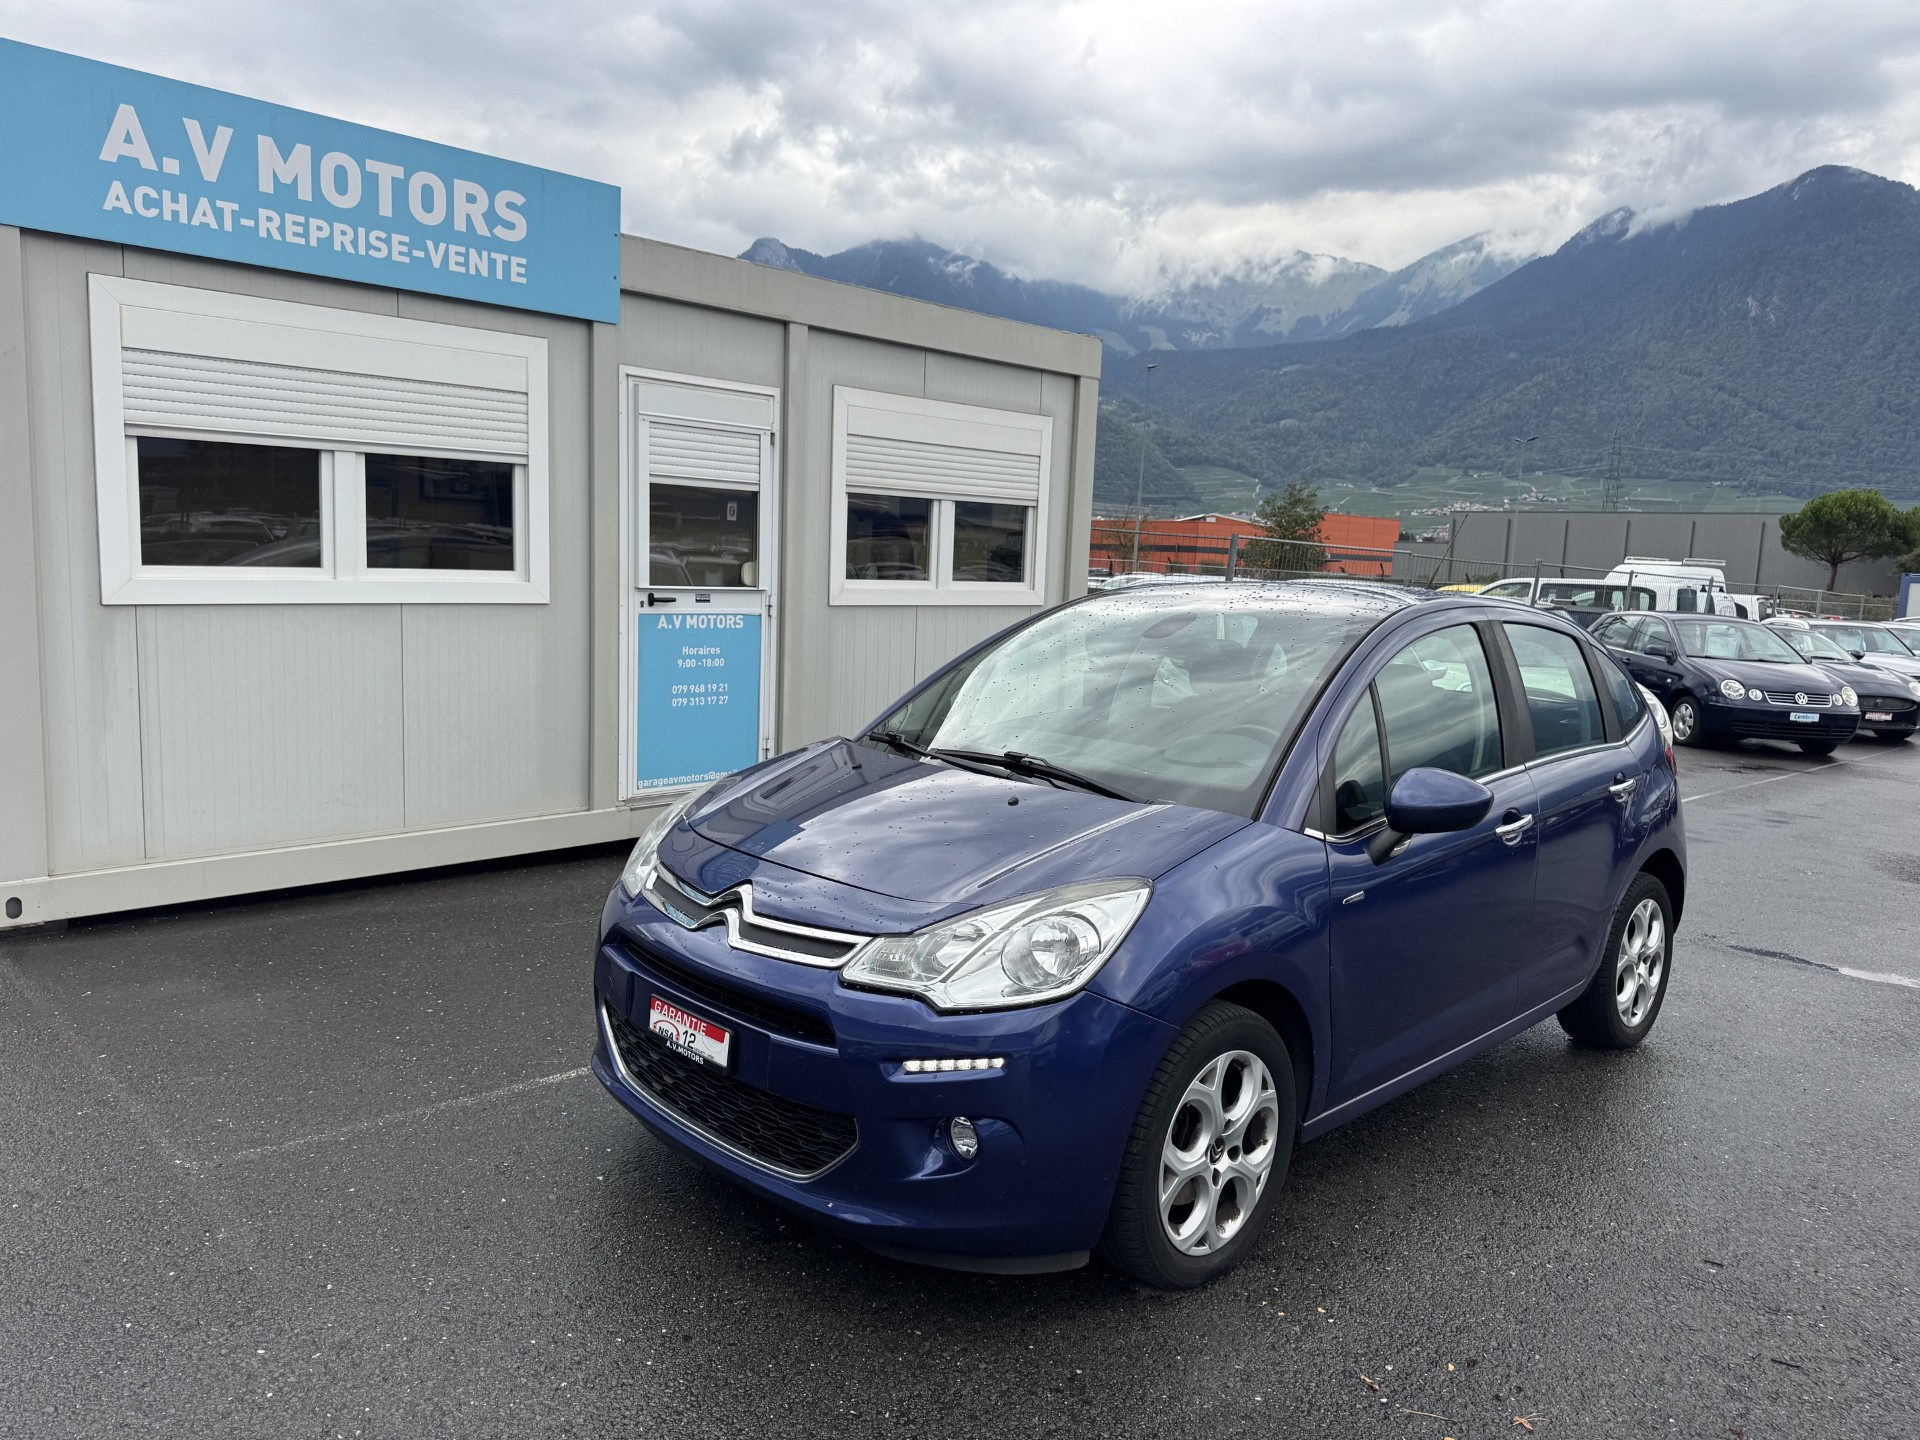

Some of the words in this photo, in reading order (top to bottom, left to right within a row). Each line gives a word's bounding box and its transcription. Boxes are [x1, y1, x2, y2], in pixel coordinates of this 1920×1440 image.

[99, 103, 234, 183] A.V
[257, 134, 528, 242] MOTORS
[102, 180, 528, 284] ACHAT-REPRISE-VENTE
[657, 614, 682, 629] A.V
[686, 614, 744, 629] MOTORS
[682, 645, 720, 655] Horaires
[677, 658, 696, 668] 9:00
[672, 685, 688, 694] 079
[689, 684, 705, 693] 968
[707, 683, 717, 693] 19
[718, 683, 728, 692] 21
[671, 697, 688, 707] 079
[689, 696, 705, 706] 313
[707, 696, 717, 705] 17
[718, 695, 729, 705] 27
[637, 768, 738, 789] garageavmotors@gm
[654, 1000, 707, 1035] GARANTIE
[658, 1026, 674, 1039] NSA
[682, 1029, 697, 1050] 12
[666, 1040, 704, 1065] A.V.MOTORS
